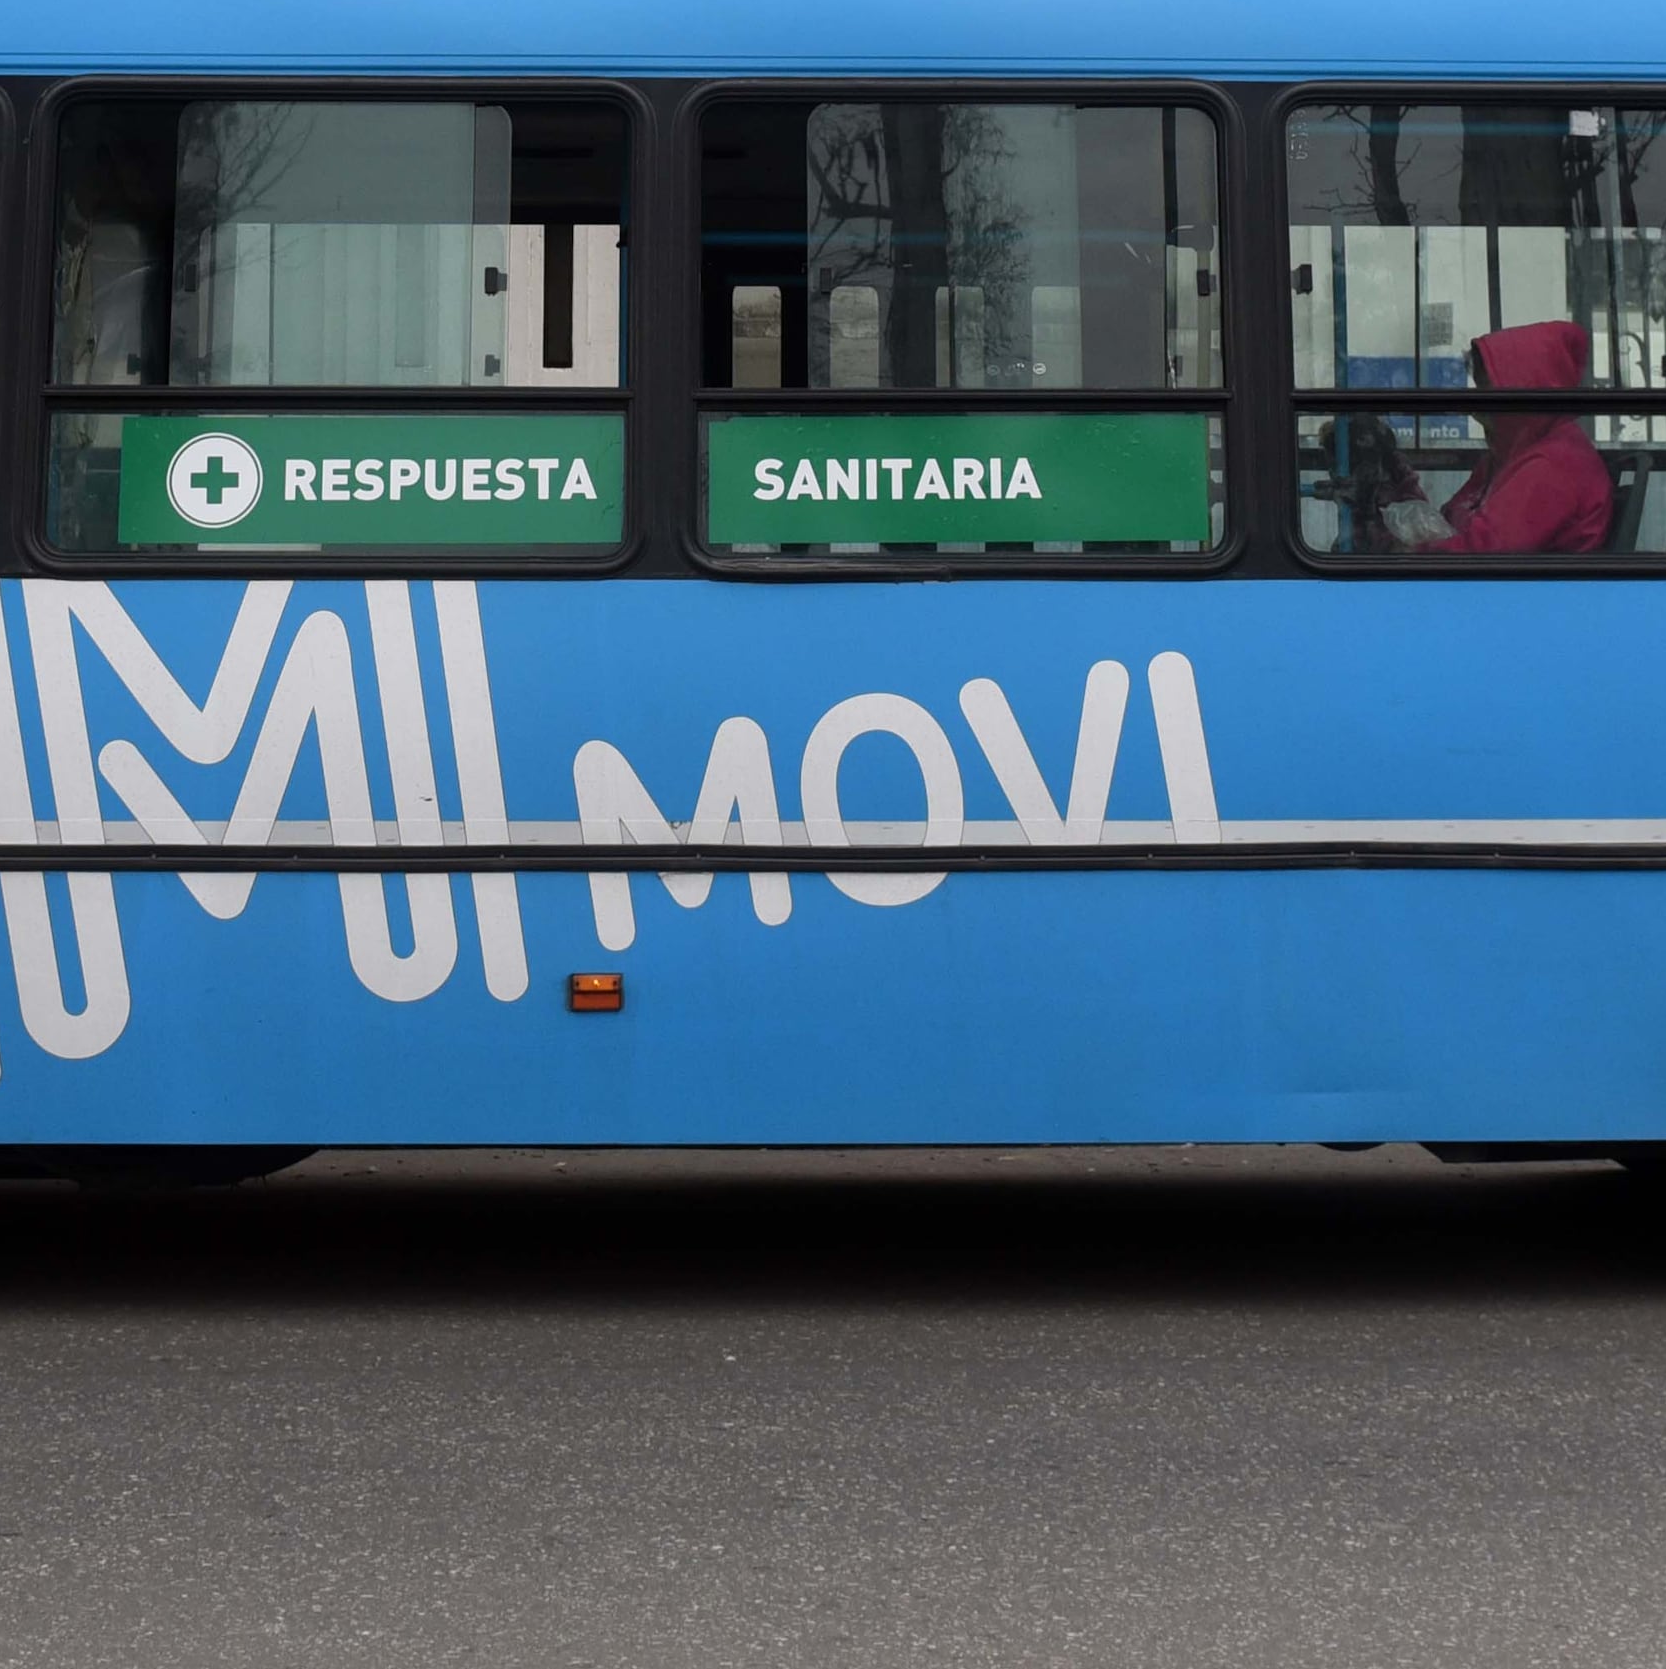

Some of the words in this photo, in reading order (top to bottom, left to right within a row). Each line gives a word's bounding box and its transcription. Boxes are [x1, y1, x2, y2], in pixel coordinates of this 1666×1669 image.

[284, 458, 598, 501] RESPUESTA
[753, 457, 1043, 501] SANITARIA
[573, 651, 1221, 952] MOVI
